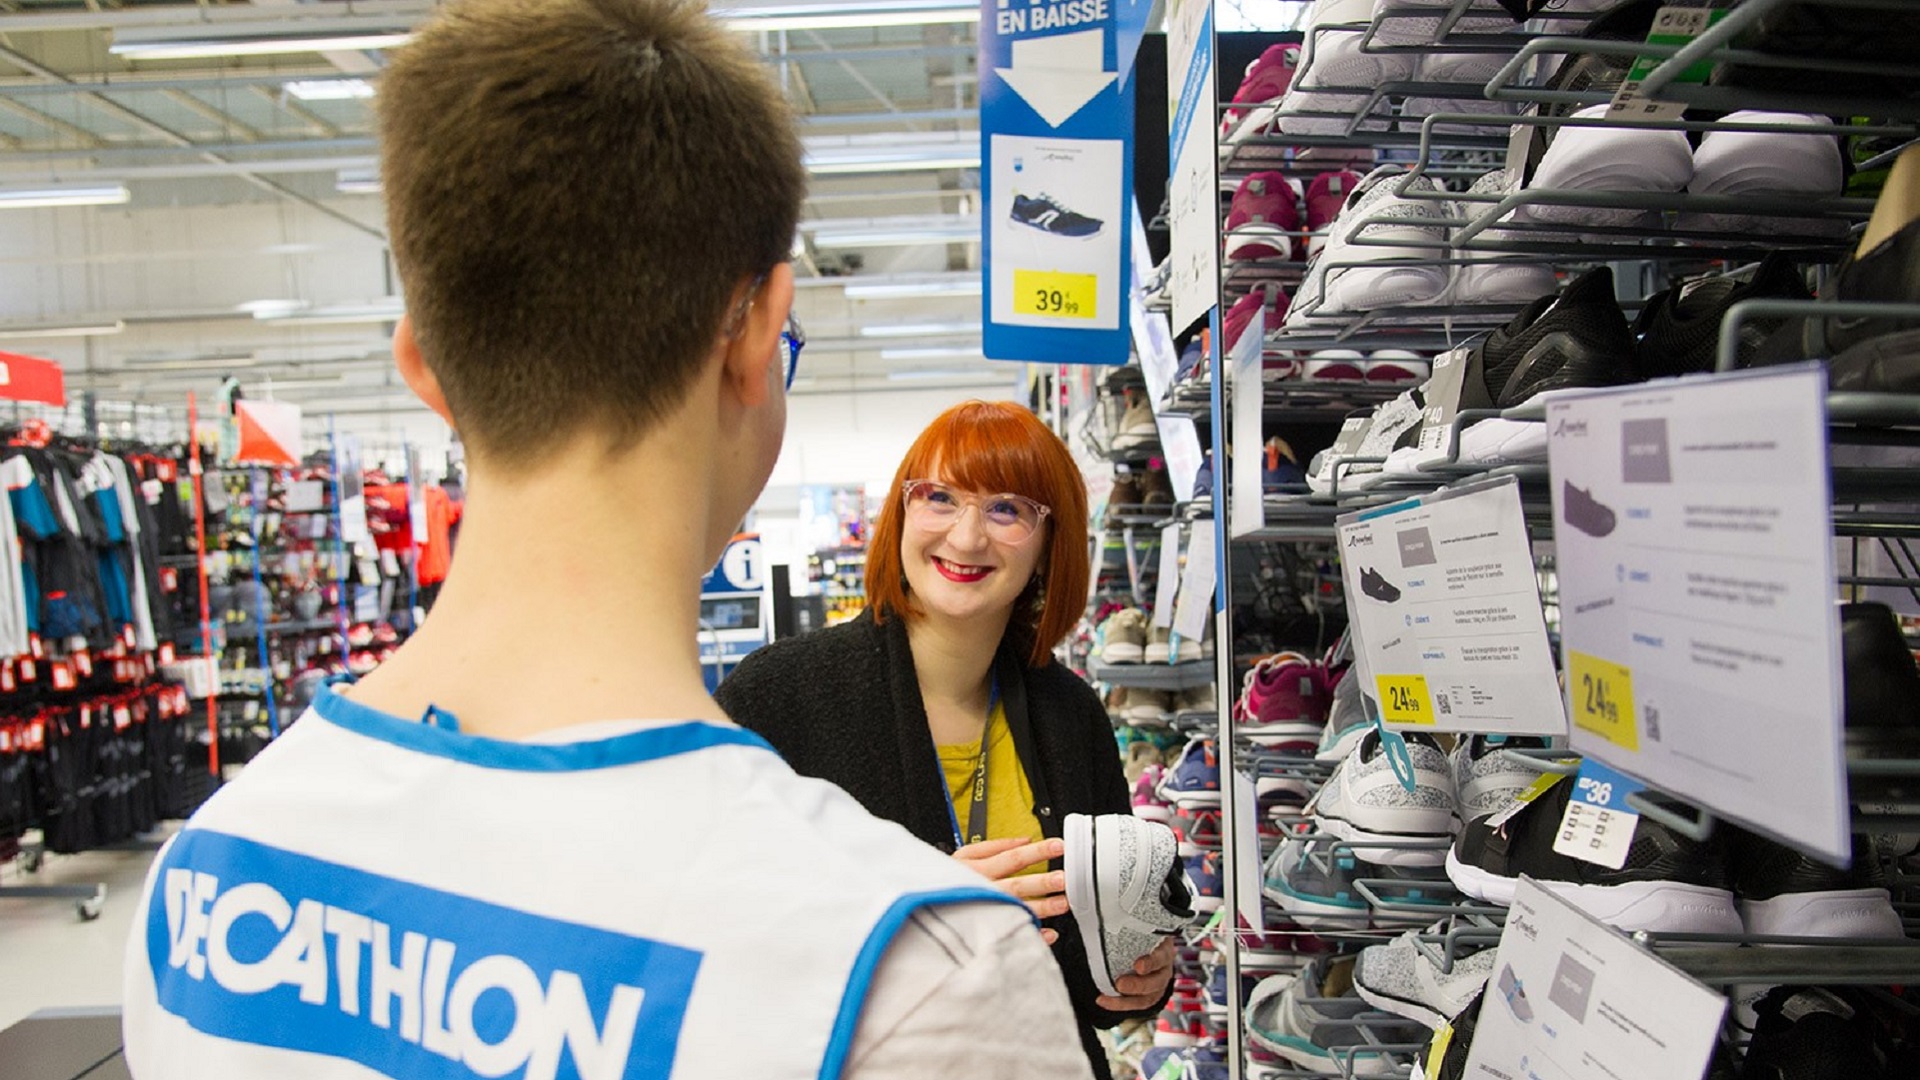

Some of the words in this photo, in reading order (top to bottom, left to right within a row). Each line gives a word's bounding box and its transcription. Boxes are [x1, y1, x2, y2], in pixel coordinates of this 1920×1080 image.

[997, 9, 1026, 35] EN
[1031, 0, 1109, 31] BAISSE
[1036, 289, 1063, 312] 39
[1389, 686, 1410, 711] 24
[1586, 780, 1613, 805] 36
[166, 868, 645, 1080] DECATHLON
